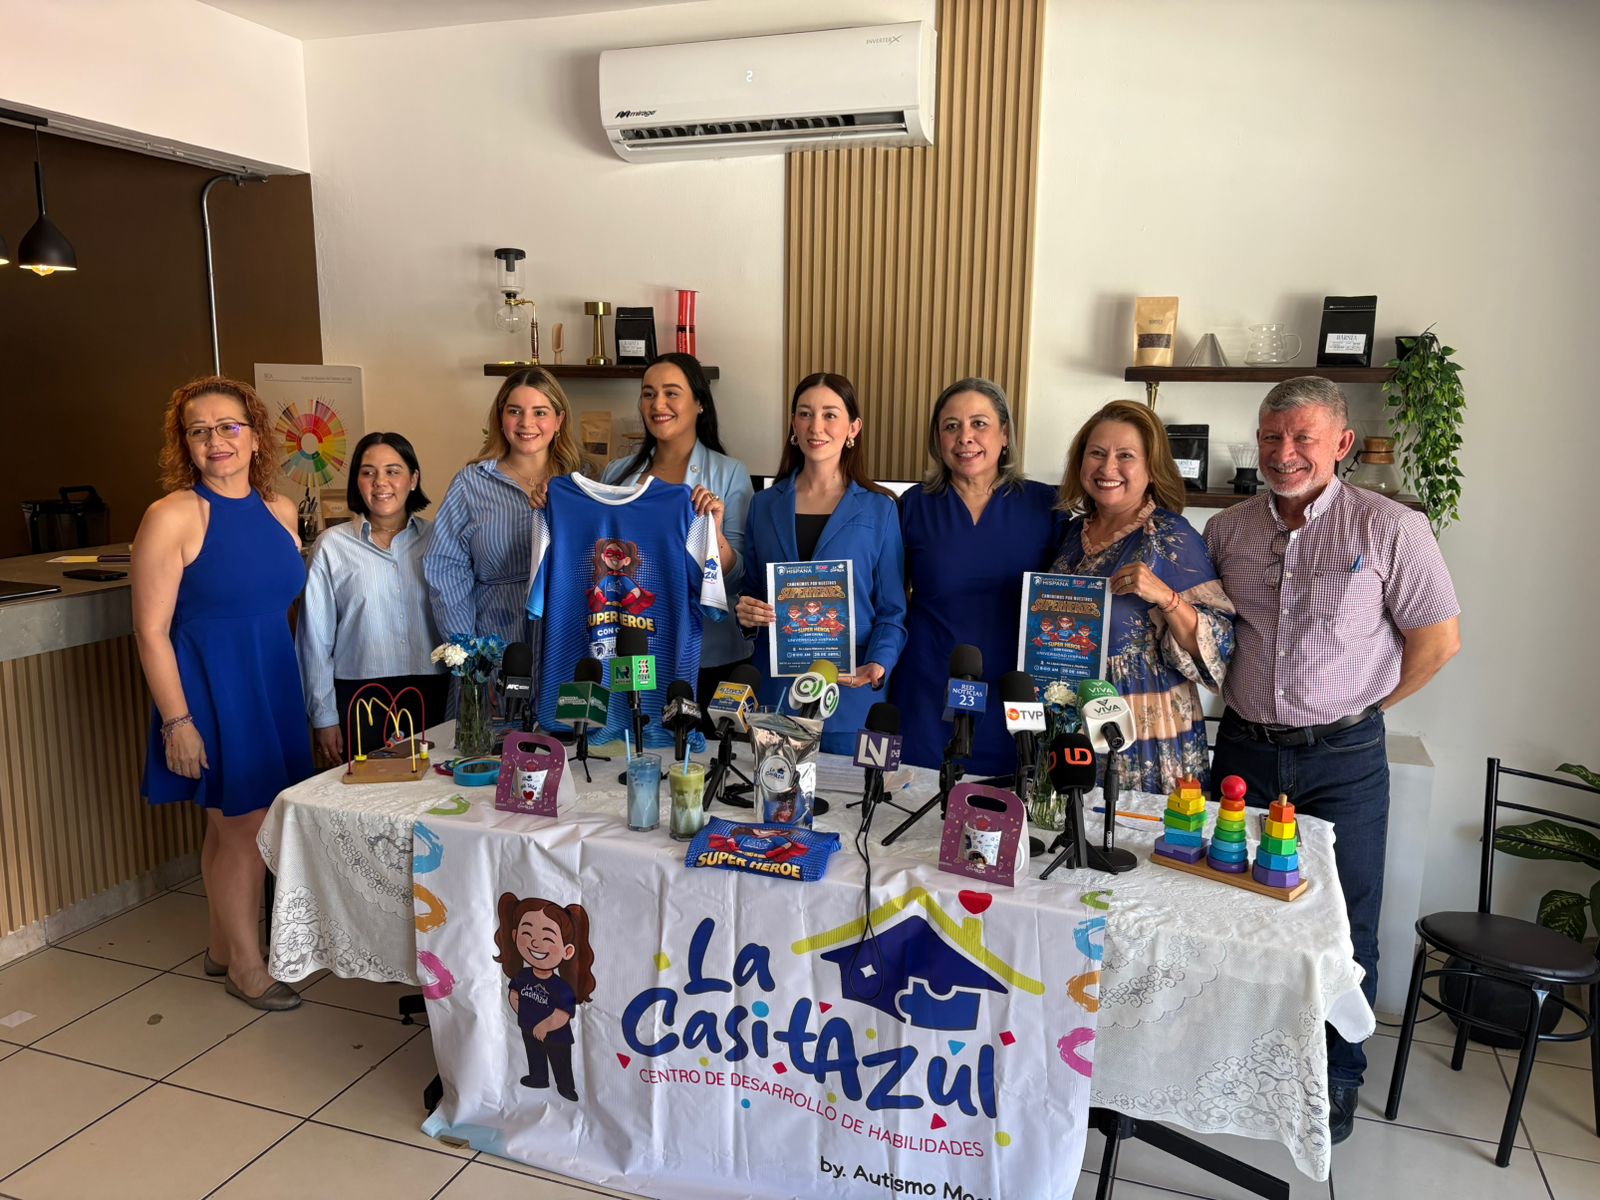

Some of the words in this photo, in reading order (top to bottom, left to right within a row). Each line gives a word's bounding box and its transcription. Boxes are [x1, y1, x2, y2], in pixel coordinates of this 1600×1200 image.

[588, 611, 619, 627] UPER
[620, 613, 655, 632] EROE
[597, 627, 614, 636] CON
[952, 688, 983, 697] NOTICIAS
[1088, 687, 1114, 695] VIVA
[959, 694, 975, 706] 23
[1020, 710, 1043, 720] TVP
[1094, 704, 1121, 714] VIVA
[696, 851, 748, 868] SUPER
[749, 861, 801, 878] HEROE
[684, 917, 775, 995] La
[622, 987, 998, 1119] CasitAzul
[639, 1068, 701, 1085] CENTRO
[705, 1071, 726, 1087] DE
[730, 1072, 838, 1122] DESARROLLO
[841, 1113, 864, 1134] DE
[868, 1126, 985, 1157] HABILIDADES
[820, 1155, 846, 1179] by.
[853, 1165, 936, 1196] Autismo
